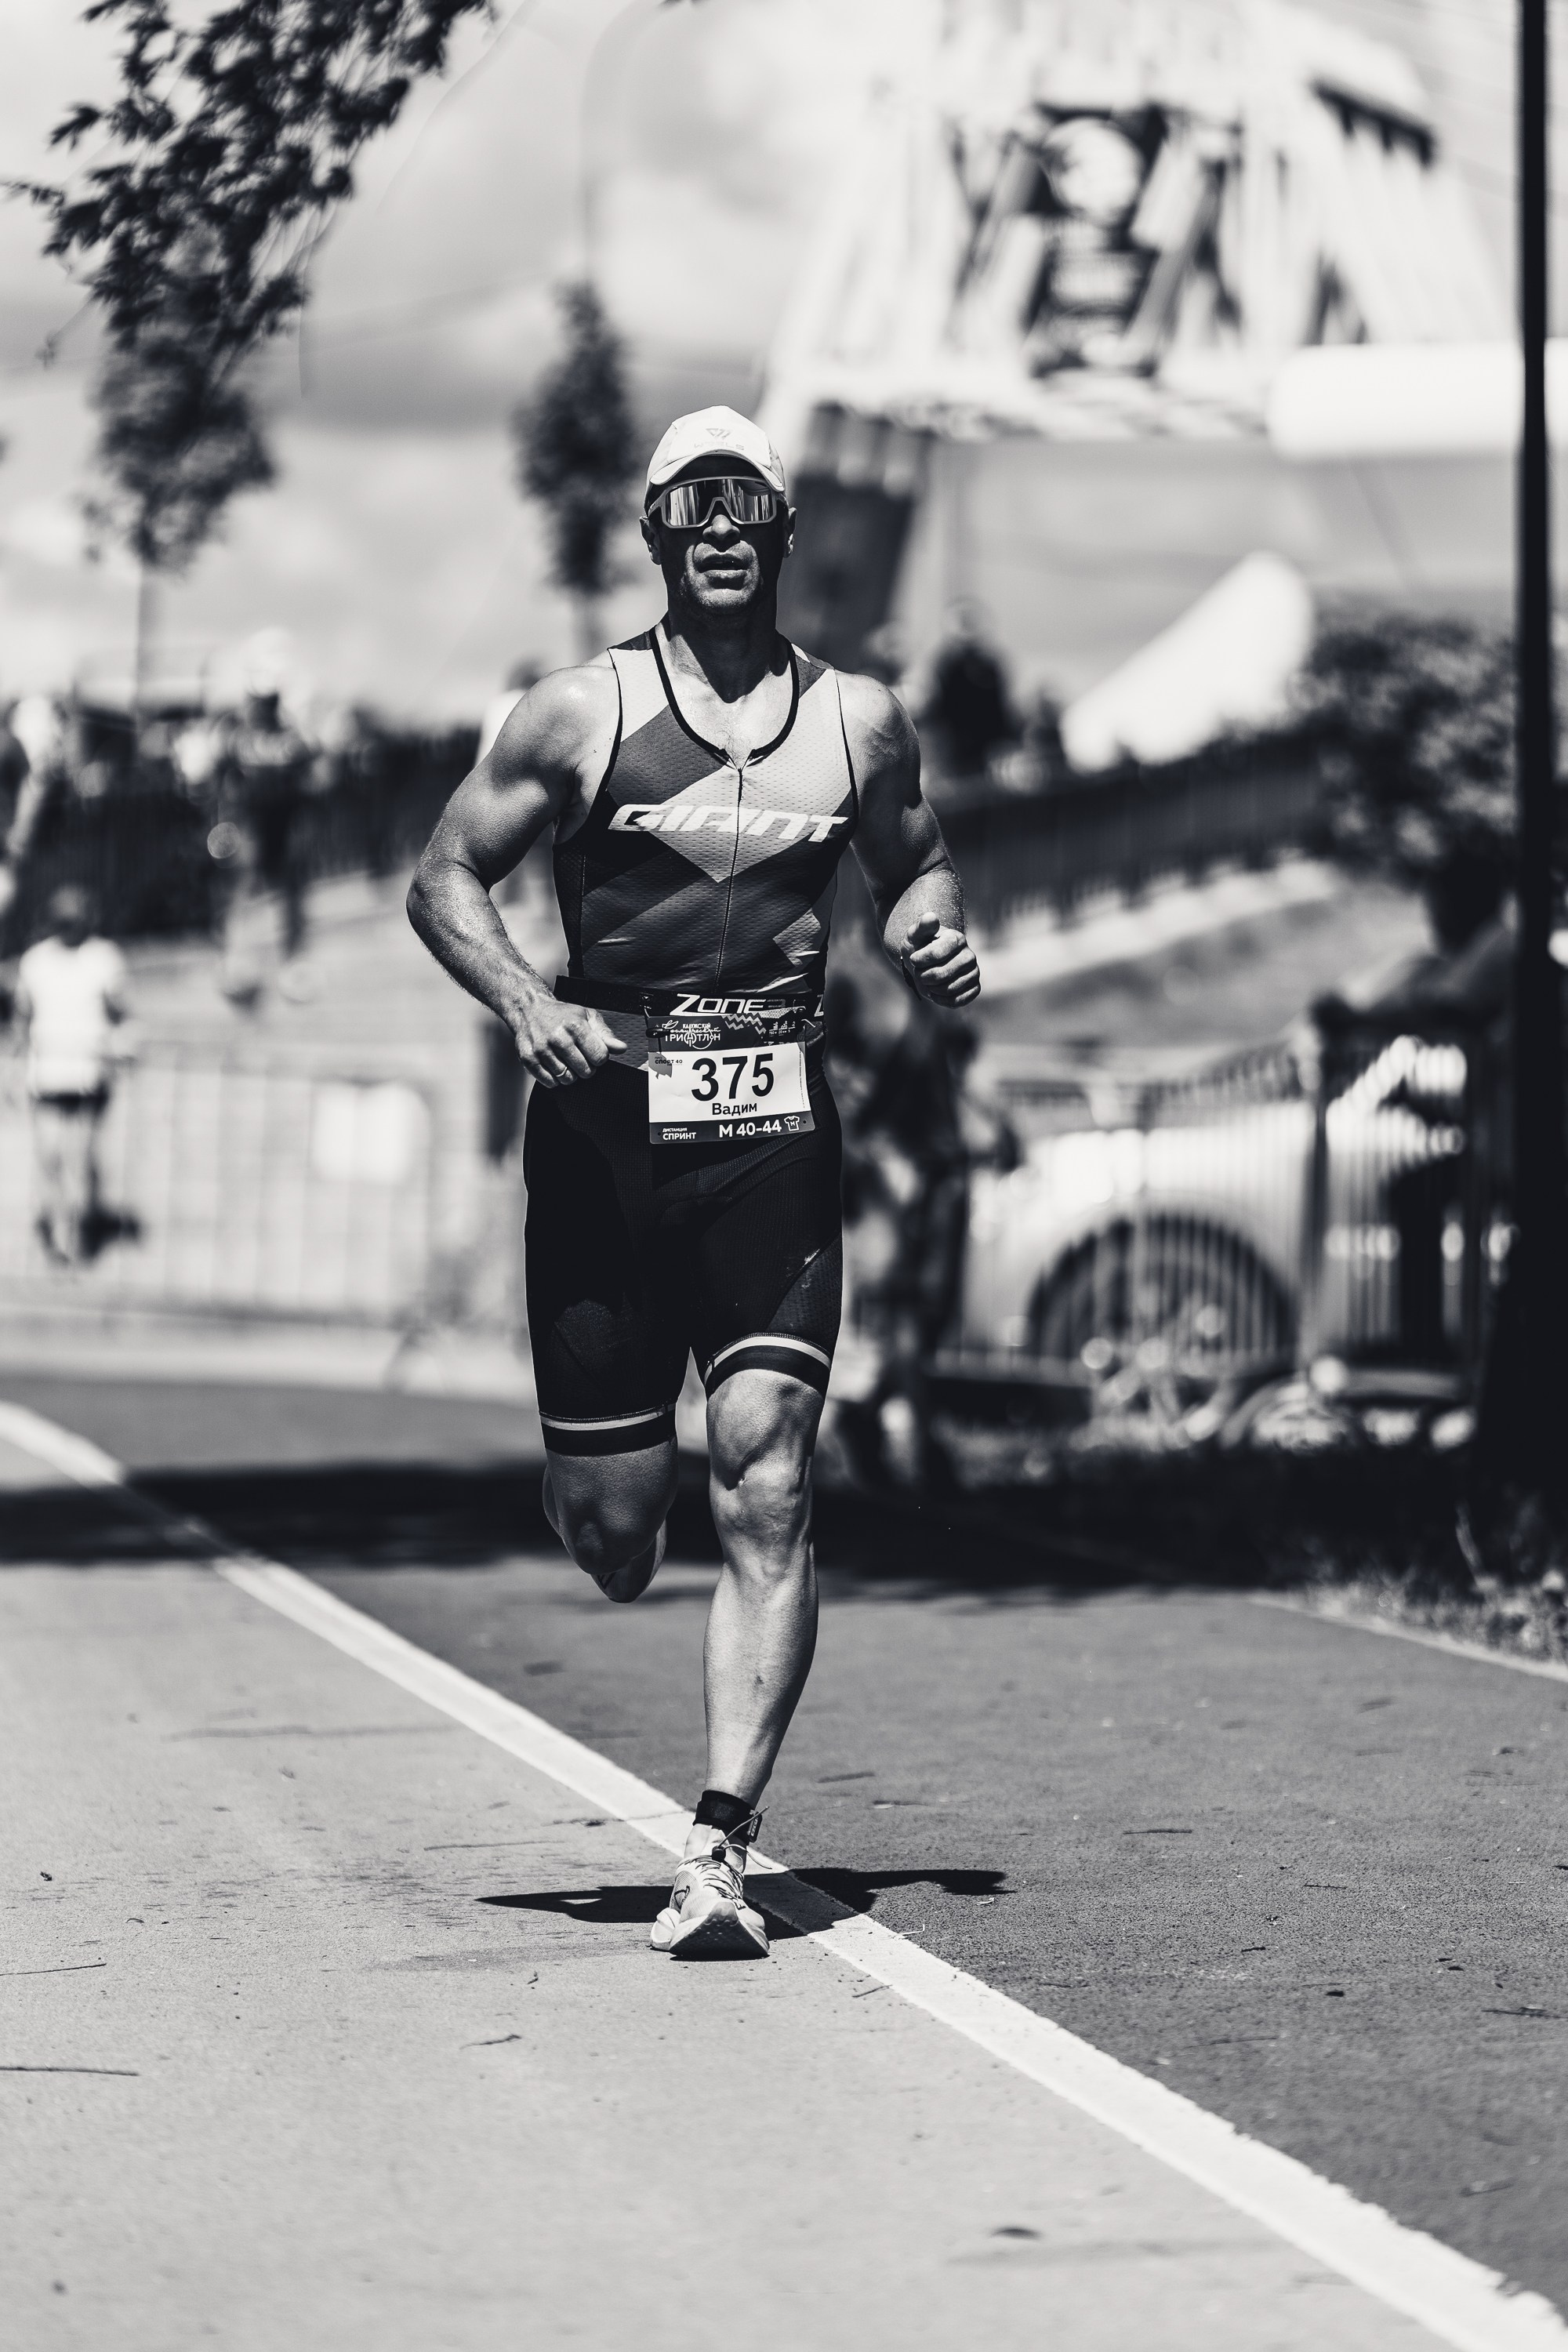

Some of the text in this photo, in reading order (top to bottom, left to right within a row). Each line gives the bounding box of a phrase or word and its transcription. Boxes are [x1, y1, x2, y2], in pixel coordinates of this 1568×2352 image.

[608, 804, 849, 843] GIANT
[691, 1053, 774, 1102] 375
[712, 1103, 757, 1116] Вадим
[662, 1132, 696, 1141] СПРИНТ
[735, 1120, 782, 1137] 40-44
